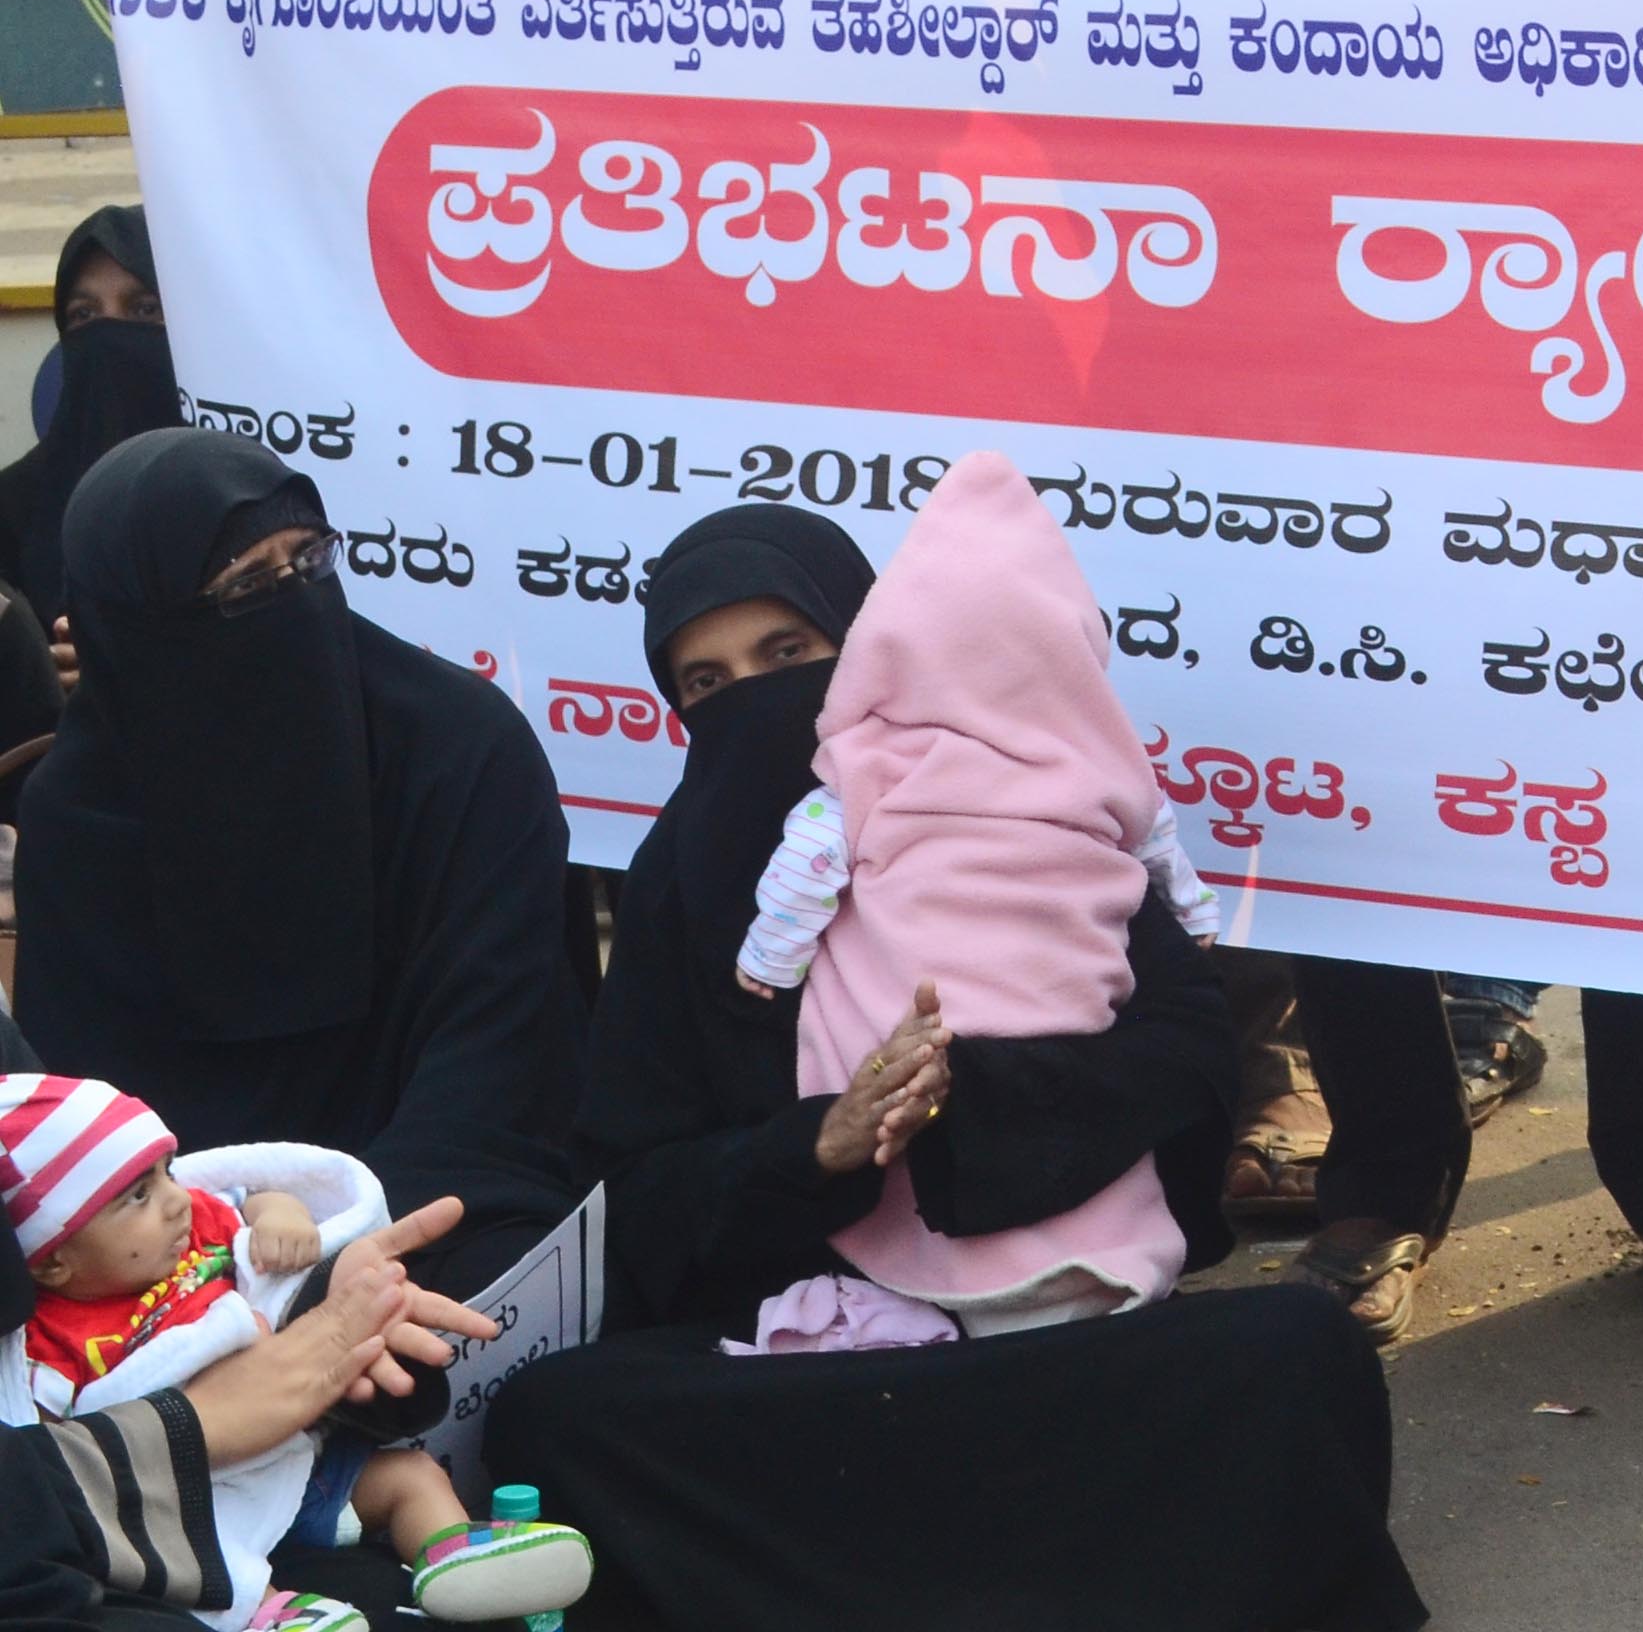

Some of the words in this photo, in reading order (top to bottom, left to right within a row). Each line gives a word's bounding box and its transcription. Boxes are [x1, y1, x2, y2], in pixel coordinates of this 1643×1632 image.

[427, 108, 1218, 318] ಪ್ರತಿಭಟನಾ
[1249, 615, 1428, 686] ಡಿ.ಸಿ.
[1433, 758, 1610, 889] ಕಸ್ಬ
